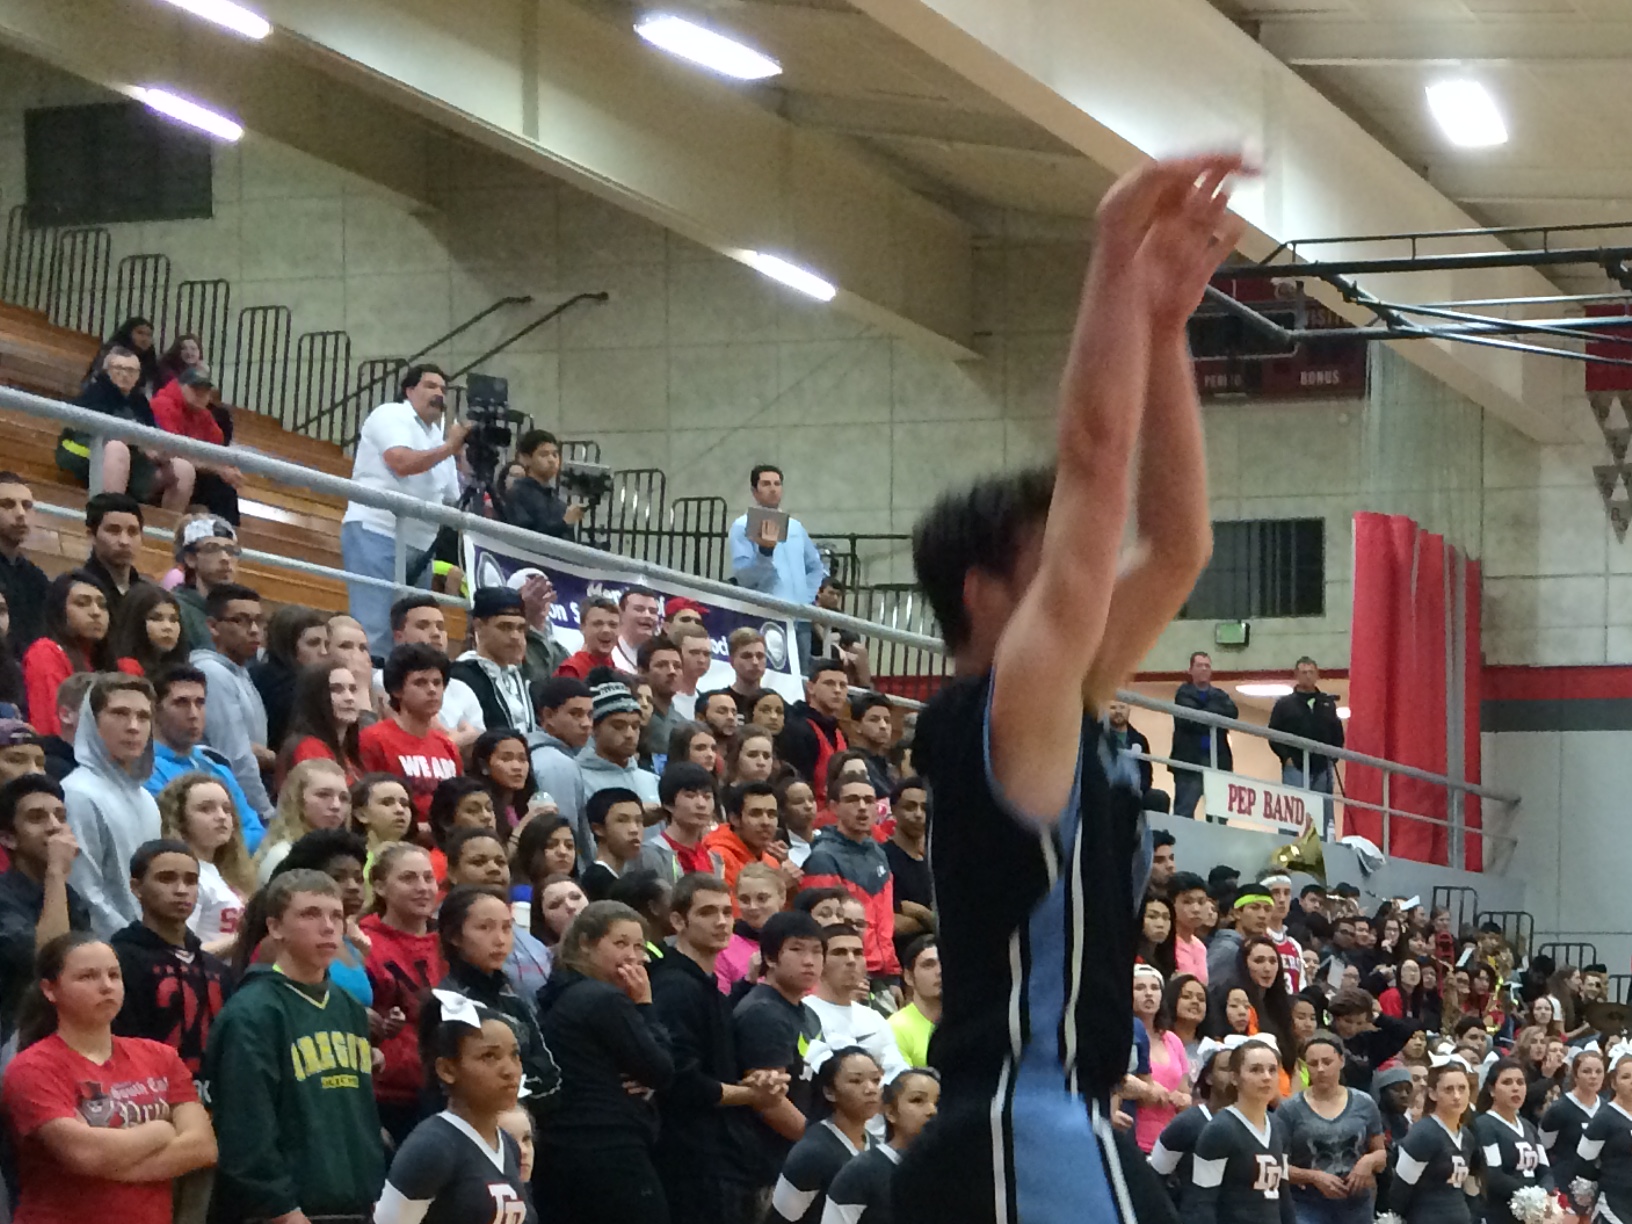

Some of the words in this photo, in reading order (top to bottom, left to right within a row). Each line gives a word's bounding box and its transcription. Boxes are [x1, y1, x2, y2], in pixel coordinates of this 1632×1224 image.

[1300, 370, 1340, 386] BONUS
[1227, 784, 1257, 816] PEP
[1263, 790, 1306, 826] BAND
